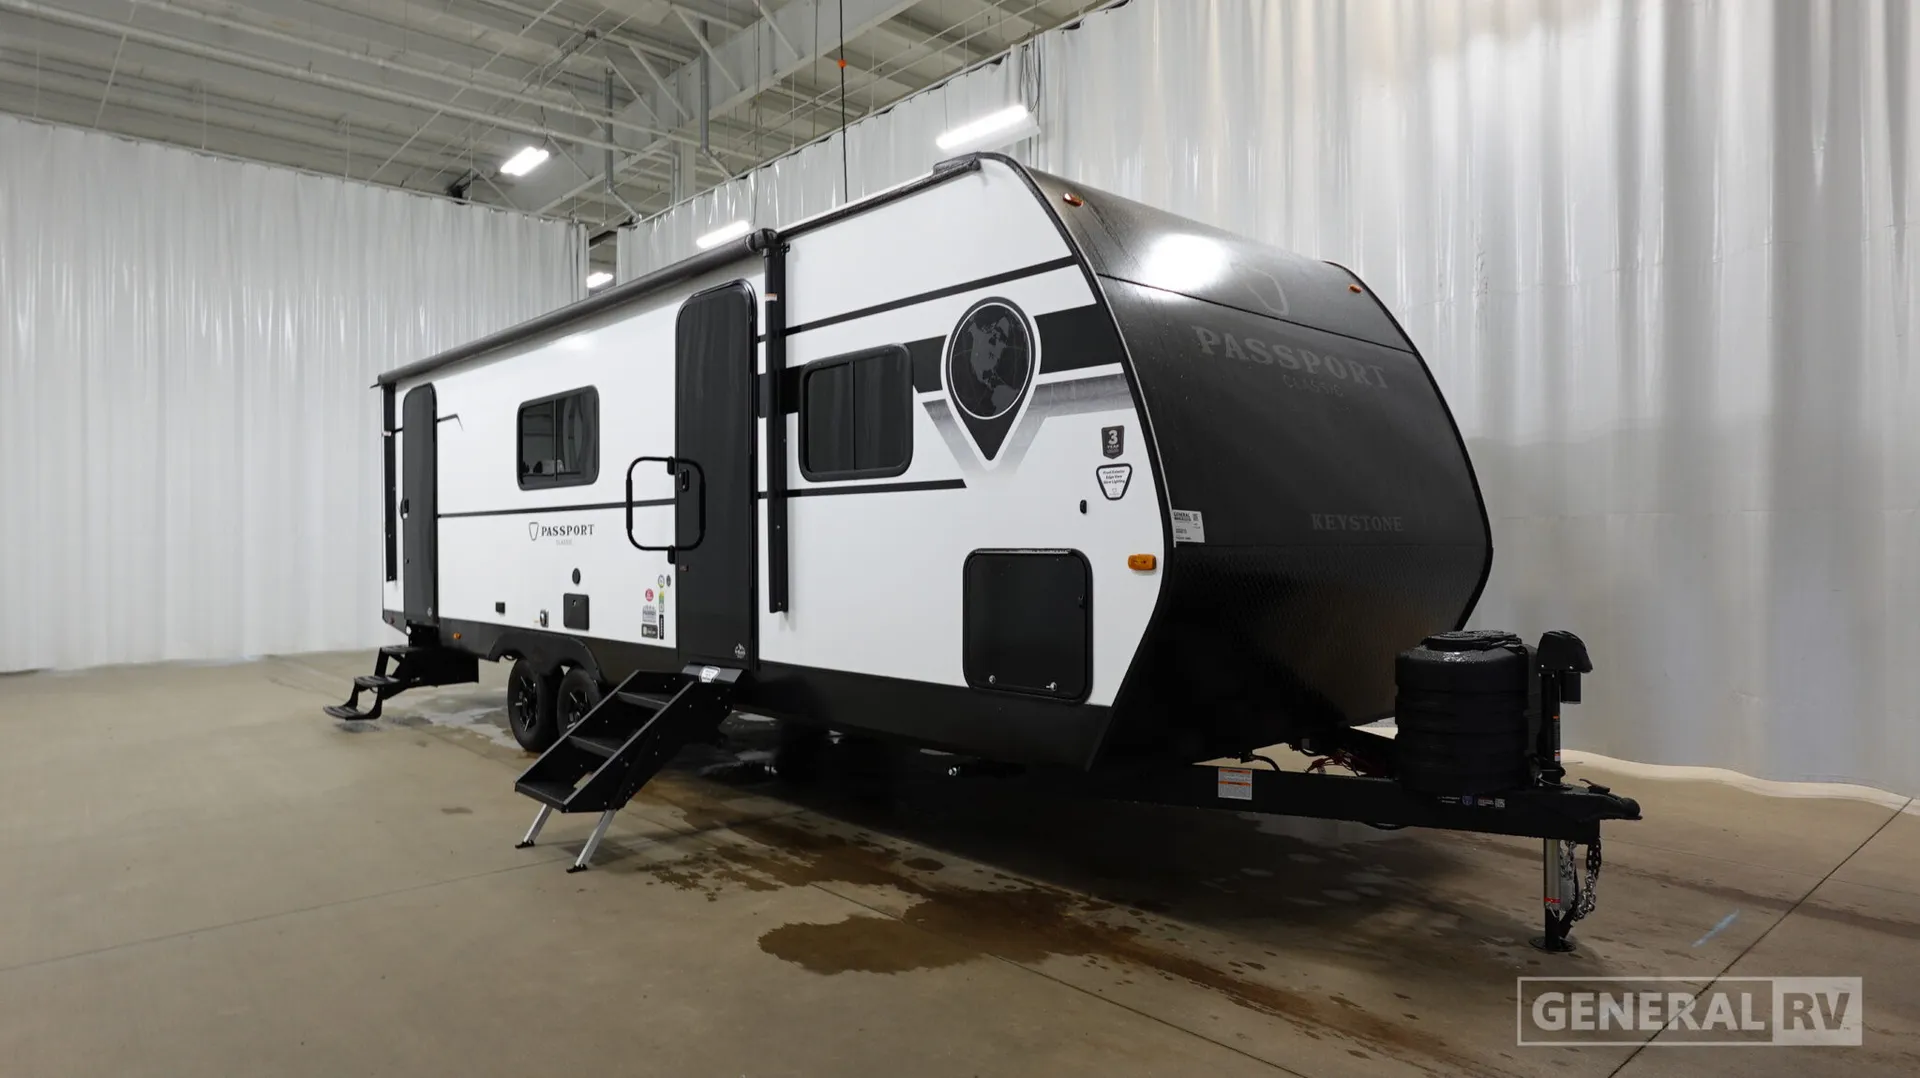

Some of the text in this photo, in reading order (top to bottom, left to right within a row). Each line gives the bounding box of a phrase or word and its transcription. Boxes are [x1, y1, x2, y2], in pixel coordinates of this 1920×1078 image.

[1191, 325, 1389, 389] PASSPORT
[1108, 429, 1118, 445] 3
[541, 524, 595, 537] PASSPORT
[1311, 513, 1404, 532] KEYSTONE
